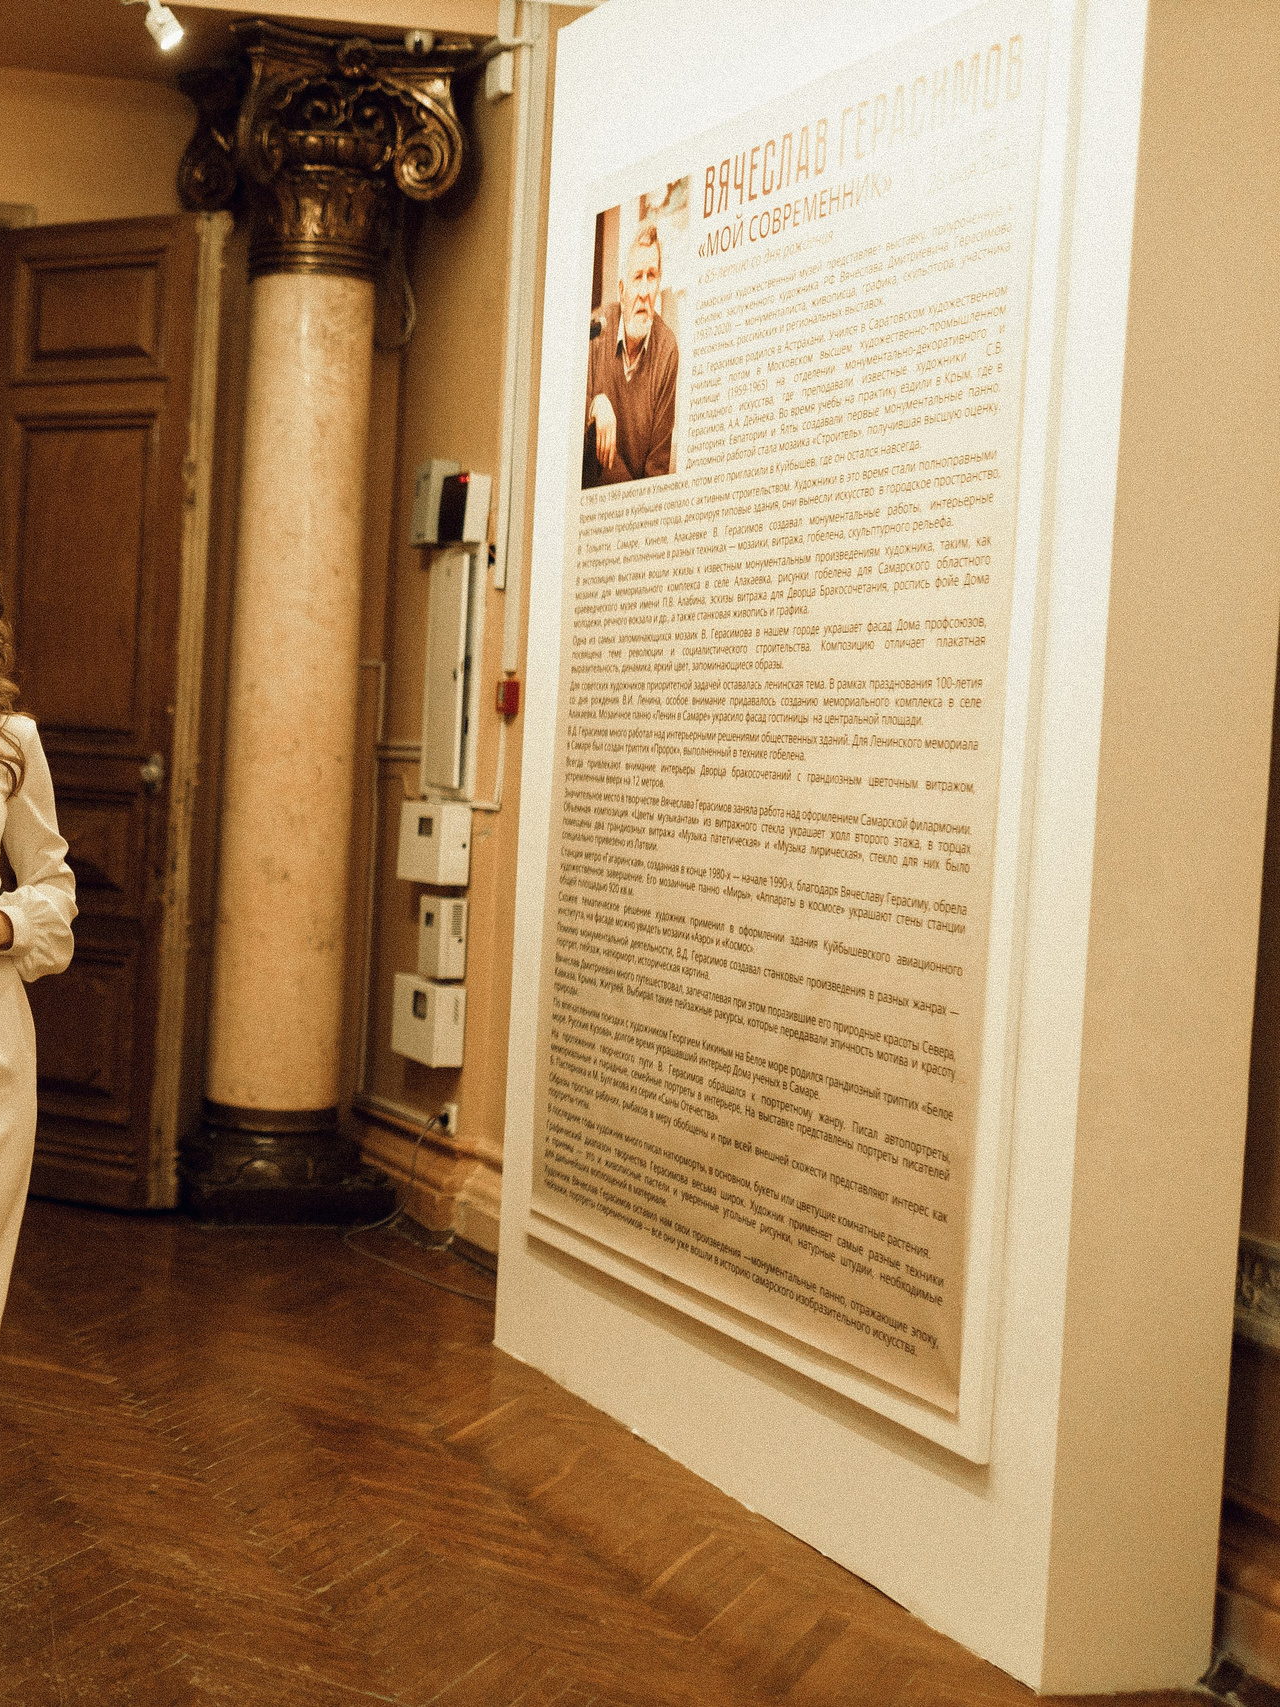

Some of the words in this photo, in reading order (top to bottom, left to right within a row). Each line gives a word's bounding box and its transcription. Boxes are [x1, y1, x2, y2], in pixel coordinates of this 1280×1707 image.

[703, 118, 828, 219] ВЯЧЕСЛАВ
[840, 34, 1023, 166] ГЕРАСИМОВ
[698, 214, 744, 259] «МОЙ
[749, 173, 893, 242] СОВРЕМЕННИК»
[694, 311, 722, 327] юбилею
[726, 295, 774, 317] заслуженного
[778, 281, 819, 303] художника
[823, 273, 835, 287] РФ
[839, 261, 883, 282] Вячеслава
[887, 240, 949, 270] Дмитриевича
[953, 220, 1013, 248] Герасимова
[750, 254, 760, 268] со
[763, 247, 781, 264] дня
[705, 355, 743, 374] Герасимов
[744, 347, 775, 365] родился
[828, 324, 858, 340] Учился
[868, 306, 925, 330] Саратовском
[928, 283, 1009, 316] художественном
[778, 407, 788, 419] Во
[790, 403, 815, 419] время
[844, 394, 854, 405] на
[858, 385, 896, 404] практику
[900, 377, 931, 393] ездили
[977, 364, 993, 378] где
[685, 451, 725, 471] Дипломной
[725, 445, 756, 465] работой
[757, 444, 777, 456] стала
[778, 438, 810, 452] мозаика
[867, 416, 921, 436] получившая
[923, 408, 962, 425] высшую
[687, 438, 725, 453] санаториях
[728, 429, 767, 445] Евпатории
[779, 423, 798, 435] Ялты
[802, 414, 843, 430] создавали
[847, 406, 879, 422] первые
[883, 389, 963, 414] монументальные
[615, 518, 658, 534] преображения
[684, 509, 720, 524] декорируя
[721, 504, 751, 517] типовые
[782, 497, 797, 508] они
[798, 492, 833, 506] вынесли
[834, 486, 874, 501] искусство
[886, 477, 931, 495] городское
[673, 530, 707, 542] Алакаевке
[724, 522, 763, 537] Герасимов
[768, 517, 802, 530] создавал
[808, 507, 880, 526] монументальные
[929, 491, 994, 510] интерьерные
[608, 649, 622, 657] теме
[628, 647, 663, 659] революции
[682, 644, 748, 656] социалистического
[820, 638, 875, 650] Композицию
[884, 637, 925, 648] отличает
[936, 634, 987, 646] плакатная
[587, 760, 621, 770] привлекают
[624, 762, 656, 772] внимание
[660, 764, 695, 776] интерьеры
[700, 764, 727, 778] Дворца
[731, 765, 792, 780] бракосочетаний
[806, 773, 862, 785] грандиозным
[867, 776, 919, 789] цветочным
[631, 808, 654, 820] «Цветы
[657, 813, 699, 825] музыкантам»
[703, 817, 711, 826] из
[714, 818, 757, 831] витражного
[760, 823, 785, 834] стекла
[789, 826, 825, 839] украшает
[830, 830, 850, 841] холл
[854, 832, 888, 846] второго
[938, 841, 971, 855] торцах
[586, 912, 593, 921] на
[594, 911, 614, 926] фасаде
[615, 918, 635, 929] можно
[636, 922, 661, 935] увидеть
[662, 927, 690, 941] мозаики
[690, 931, 714, 947] «Аэро»
[623, 904, 651, 917] решение
[655, 910, 686, 924] художник
[689, 917, 725, 931] применил
[738, 923, 785, 943] оформлении
[789, 935, 818, 949] здания
[822, 938, 891, 963] Куйбышевского
[896, 954, 964, 977] авиационного
[635, 1037, 654, 1050] время
[656, 1043, 697, 1063] украшавший
[699, 1056, 731, 1076] интерьер
[732, 1063, 751, 1080] Дома
[752, 1072, 780, 1088] ученых
[614, 1148, 647, 1169] творчества
[649, 1160, 688, 1185] Герасимова
[691, 1179, 717, 1197] весьма
[749, 1199, 784, 1224] Художник
[788, 1218, 832, 1244] применяет
[836, 1237, 863, 1257] самые
[867, 1249, 900, 1272] разные
[905, 1264, 945, 1290] техники
